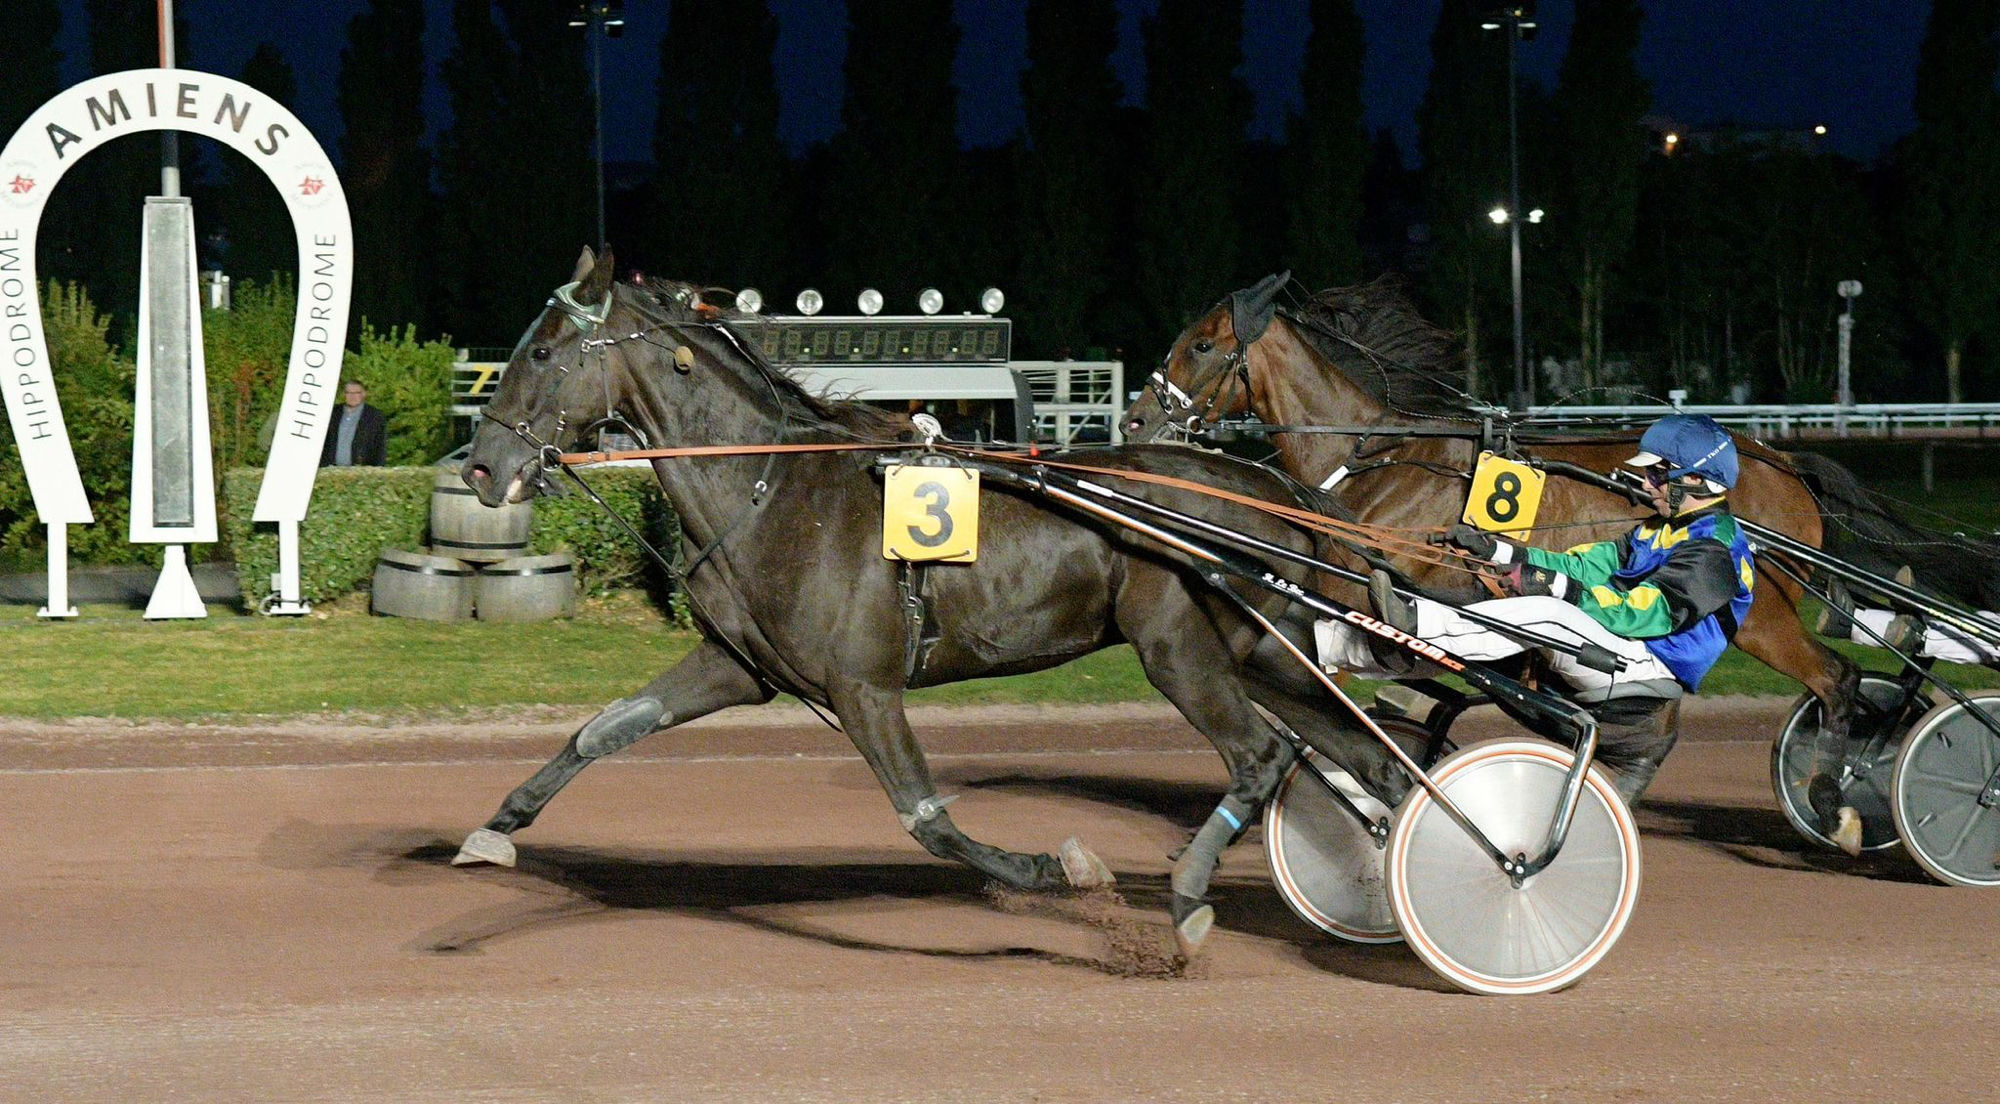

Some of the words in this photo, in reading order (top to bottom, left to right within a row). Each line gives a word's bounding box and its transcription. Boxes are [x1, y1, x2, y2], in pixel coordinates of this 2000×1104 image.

[46, 83, 289, 160] AMIENS
[0, 228, 52, 440] HIPPODROME
[290, 233, 336, 440] HIPPODROME
[469, 364, 496, 397] 7
[906, 480, 954, 547] 3
[1485, 471, 1522, 524] 8
[1344, 610, 1447, 661] CUSTOM
